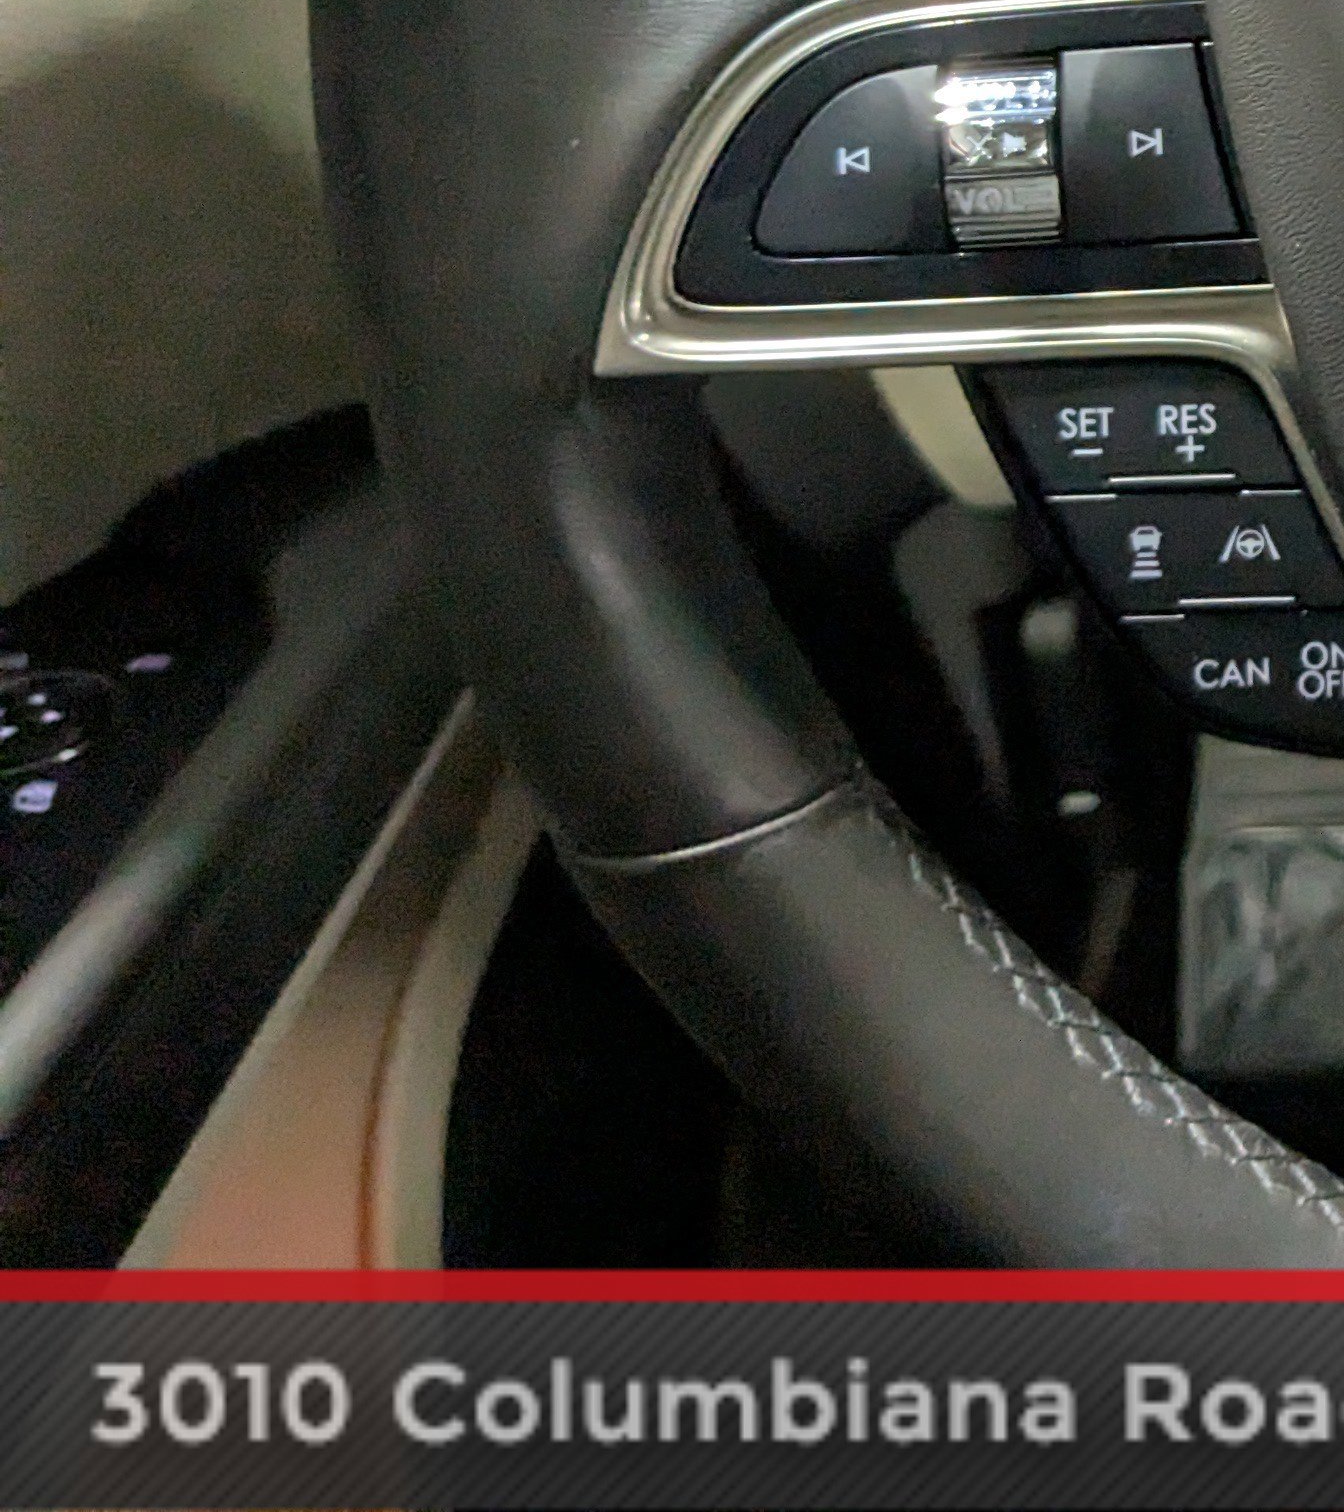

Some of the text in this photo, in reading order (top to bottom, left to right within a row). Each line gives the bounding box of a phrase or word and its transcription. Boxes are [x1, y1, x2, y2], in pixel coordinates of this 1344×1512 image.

[1058, 406, 1115, 439] SET
[1157, 402, 1218, 436] RES
[1193, 657, 1271, 690] CAN
